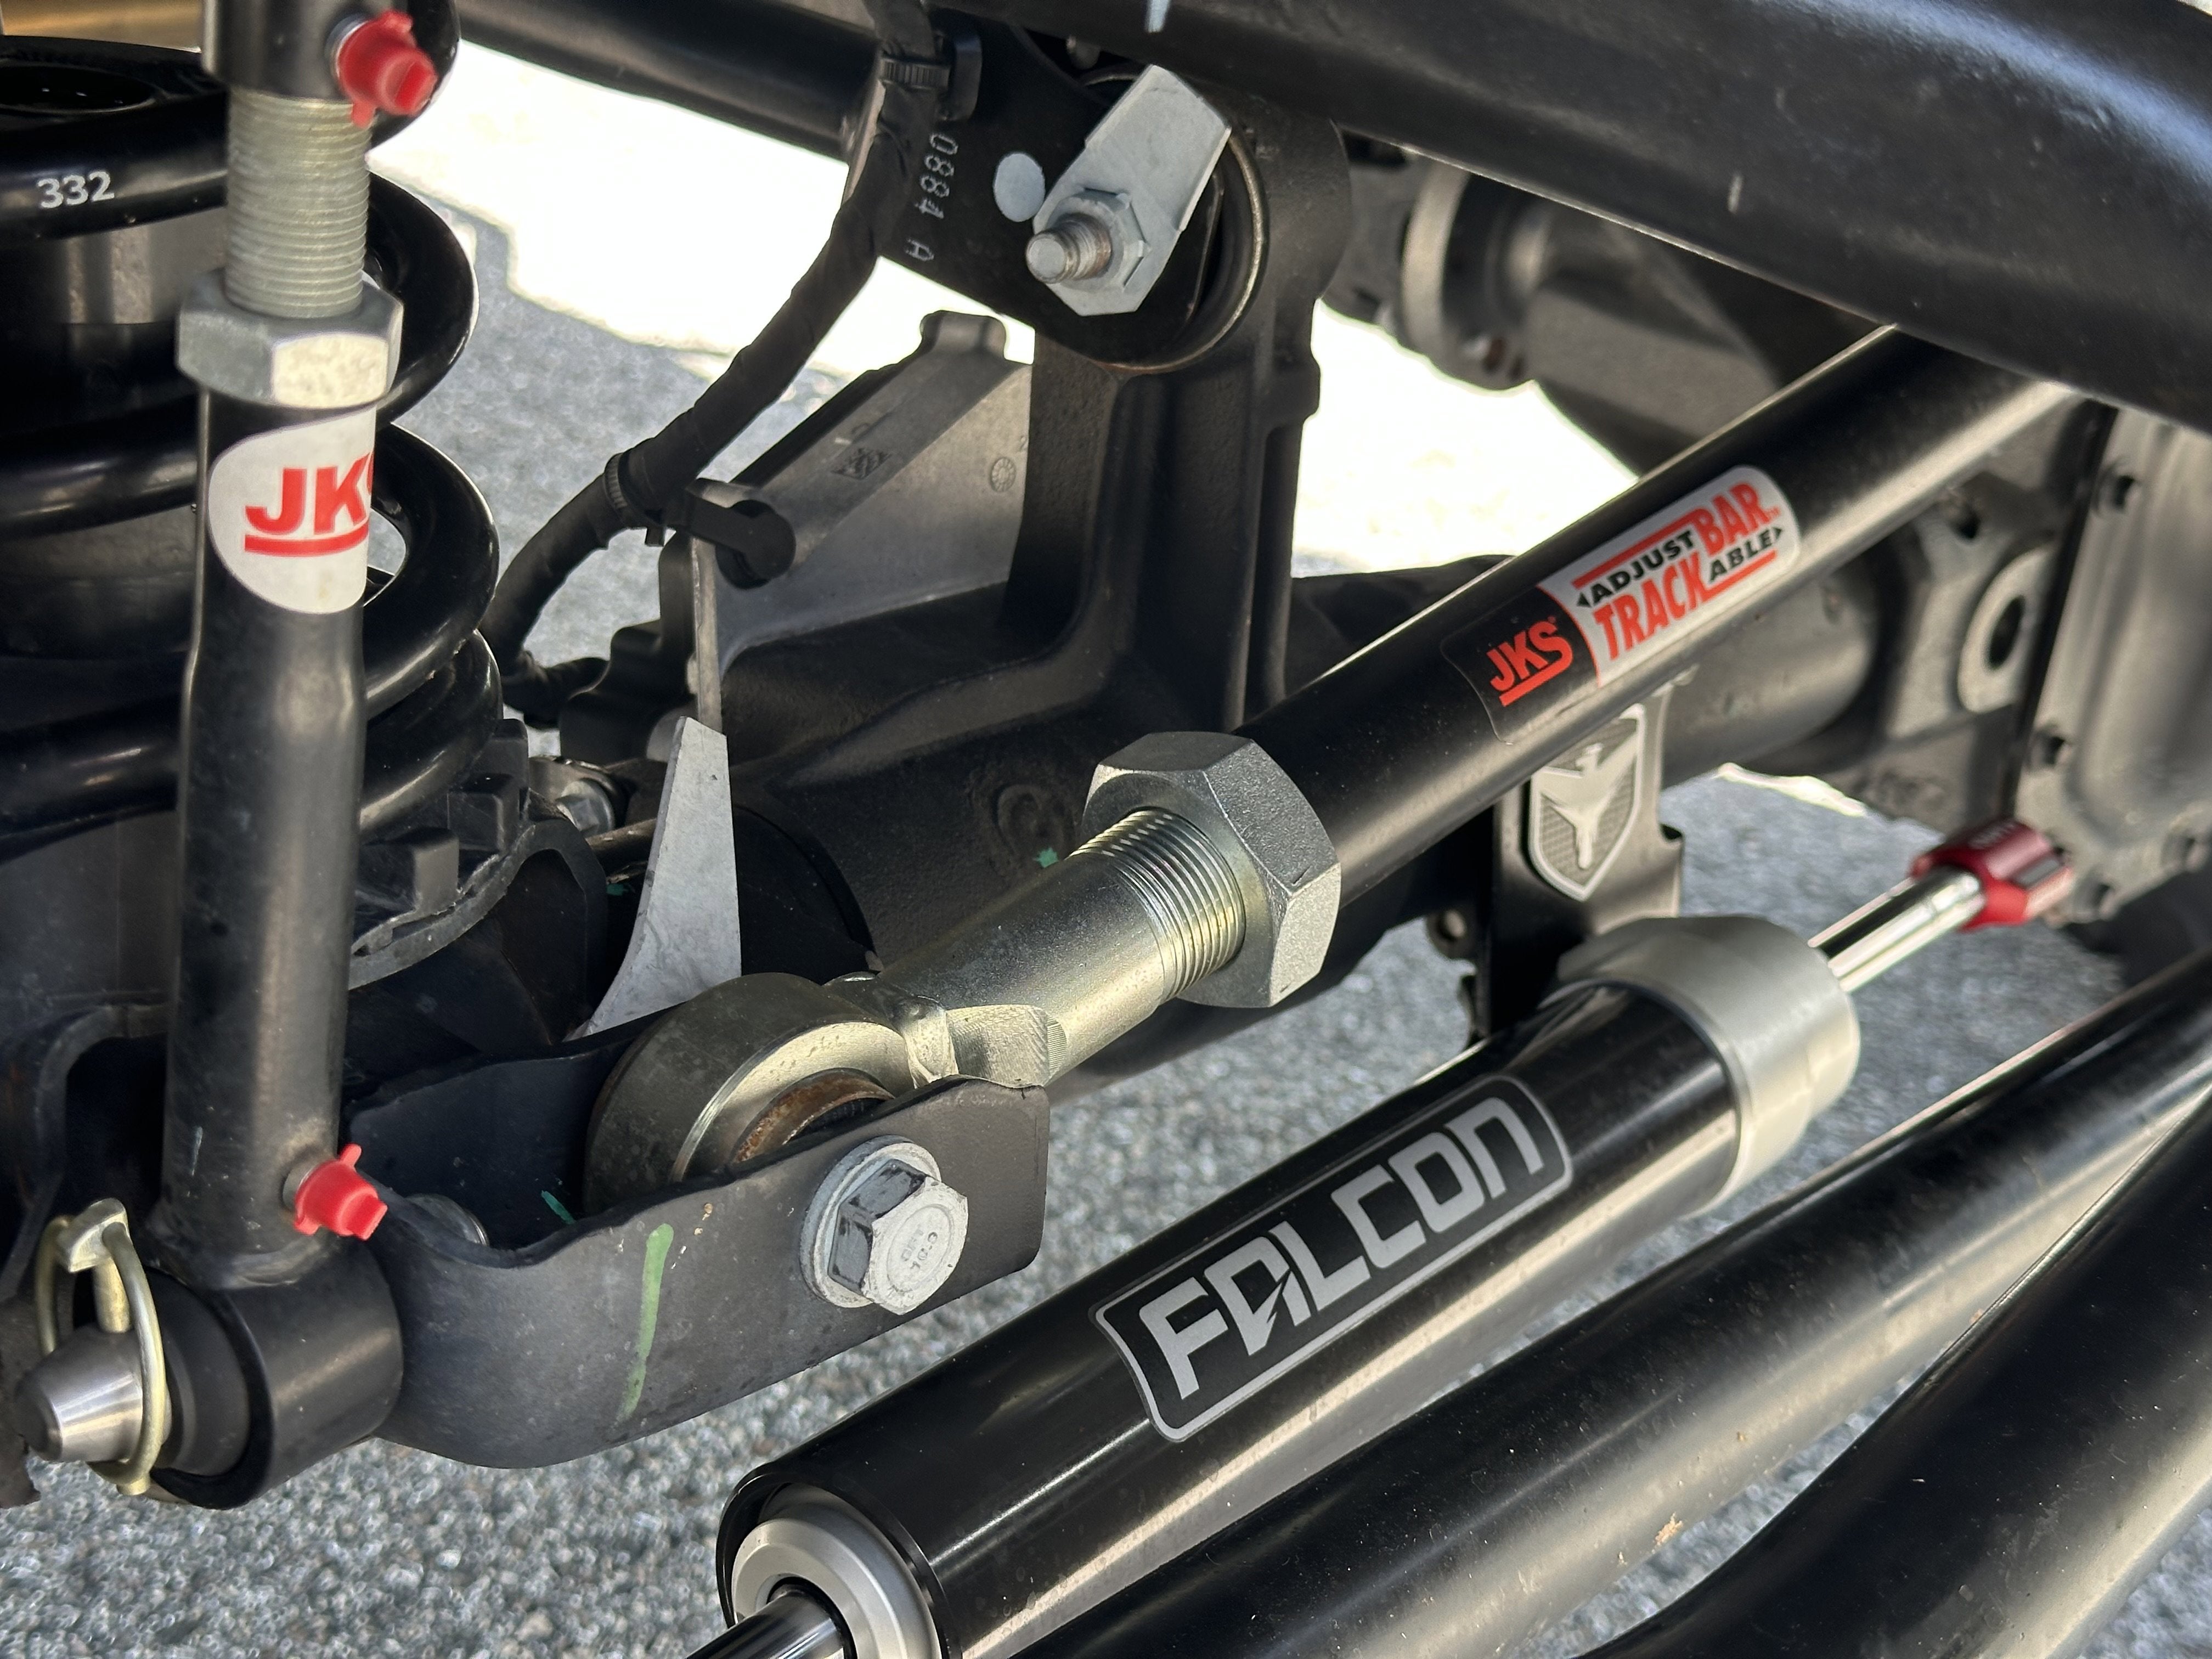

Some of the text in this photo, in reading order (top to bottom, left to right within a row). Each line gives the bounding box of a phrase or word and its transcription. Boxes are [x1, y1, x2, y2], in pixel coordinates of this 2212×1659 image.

[36, 170, 115, 209] 332
[905, 238, 935, 262] A
[245, 452, 374, 557] JK
[1694, 483, 1770, 556] BAR
[1590, 529, 1695, 606] ADJUST
[1708, 528, 1773, 583] ABLE
[1593, 551, 1702, 661] TRACK
[1486, 620, 1573, 708] JKS
[1138, 1097, 1544, 1401] FALCON
